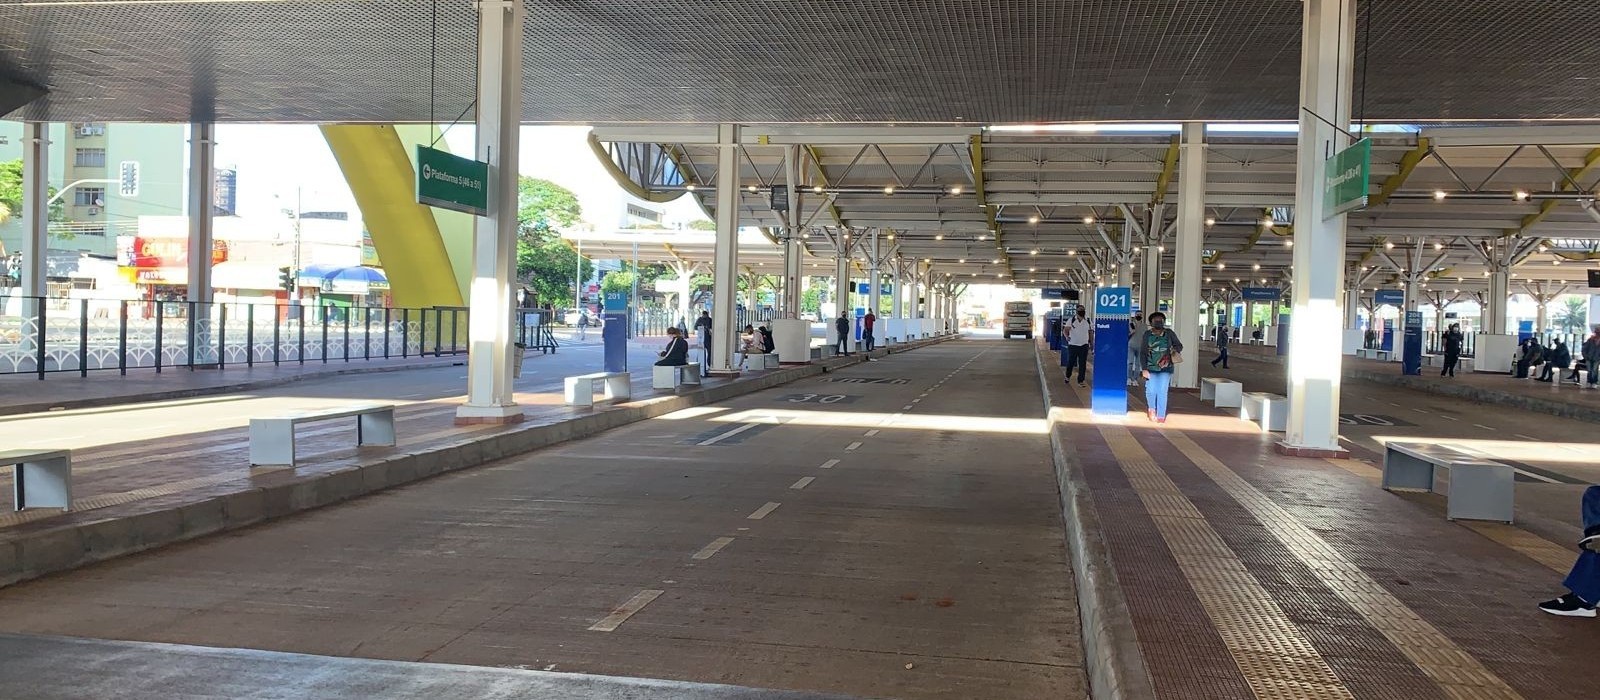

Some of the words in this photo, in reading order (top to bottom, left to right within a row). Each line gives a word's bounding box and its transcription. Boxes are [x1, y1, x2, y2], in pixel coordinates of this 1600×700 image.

[431, 169, 458, 185] Plataforma
[1100, 294, 1126, 307] 021
[788, 394, 847, 404] 30
